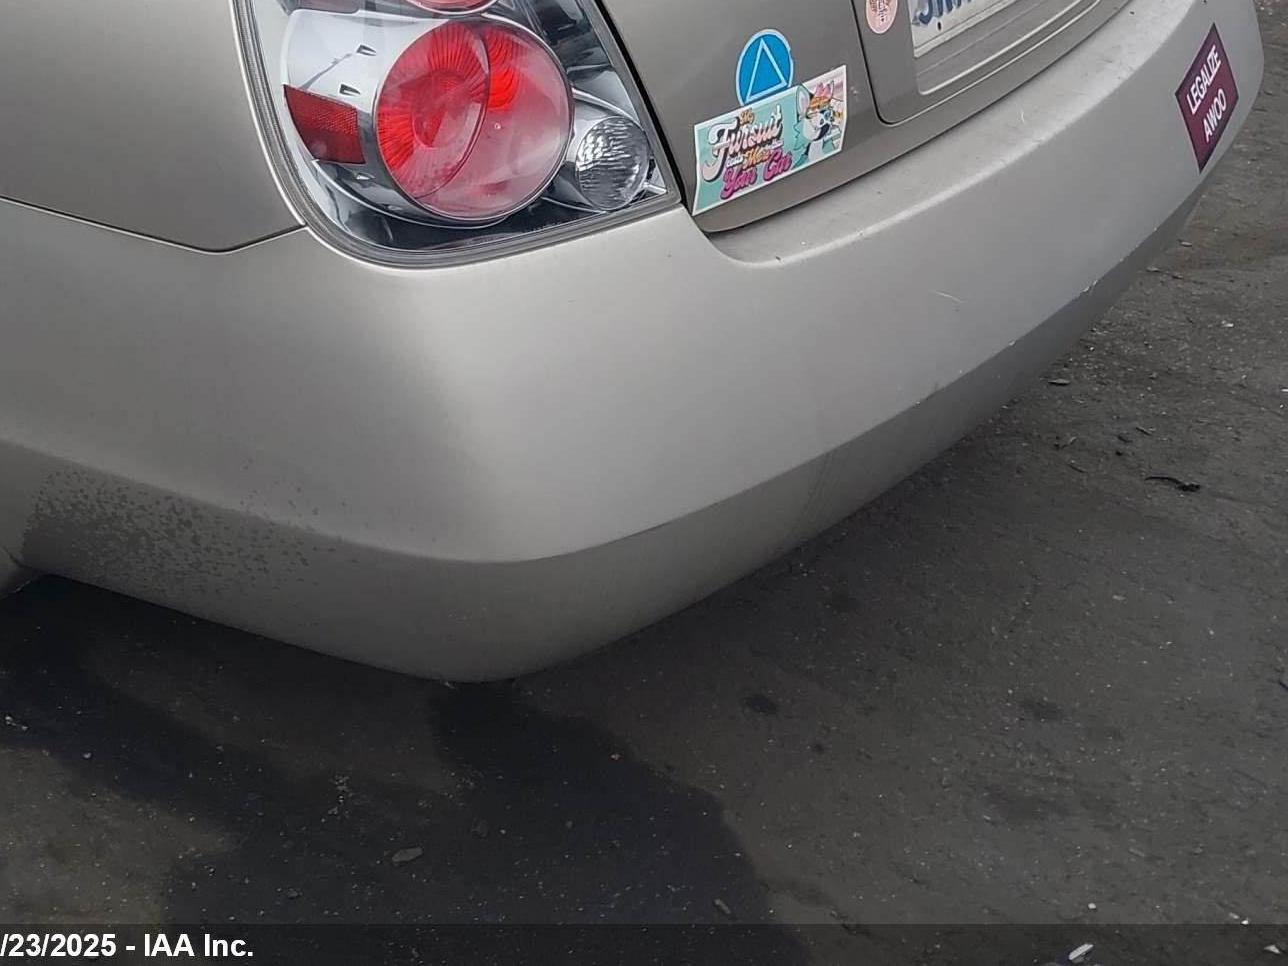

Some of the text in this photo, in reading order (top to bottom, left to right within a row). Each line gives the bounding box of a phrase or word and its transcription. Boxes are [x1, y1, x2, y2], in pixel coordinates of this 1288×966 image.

[1186, 44, 1222, 116] LEGALIZE
[702, 104, 783, 182] Fursuit
[1202, 88, 1227, 143] AWOO
[721, 145, 793, 200] Your Car
